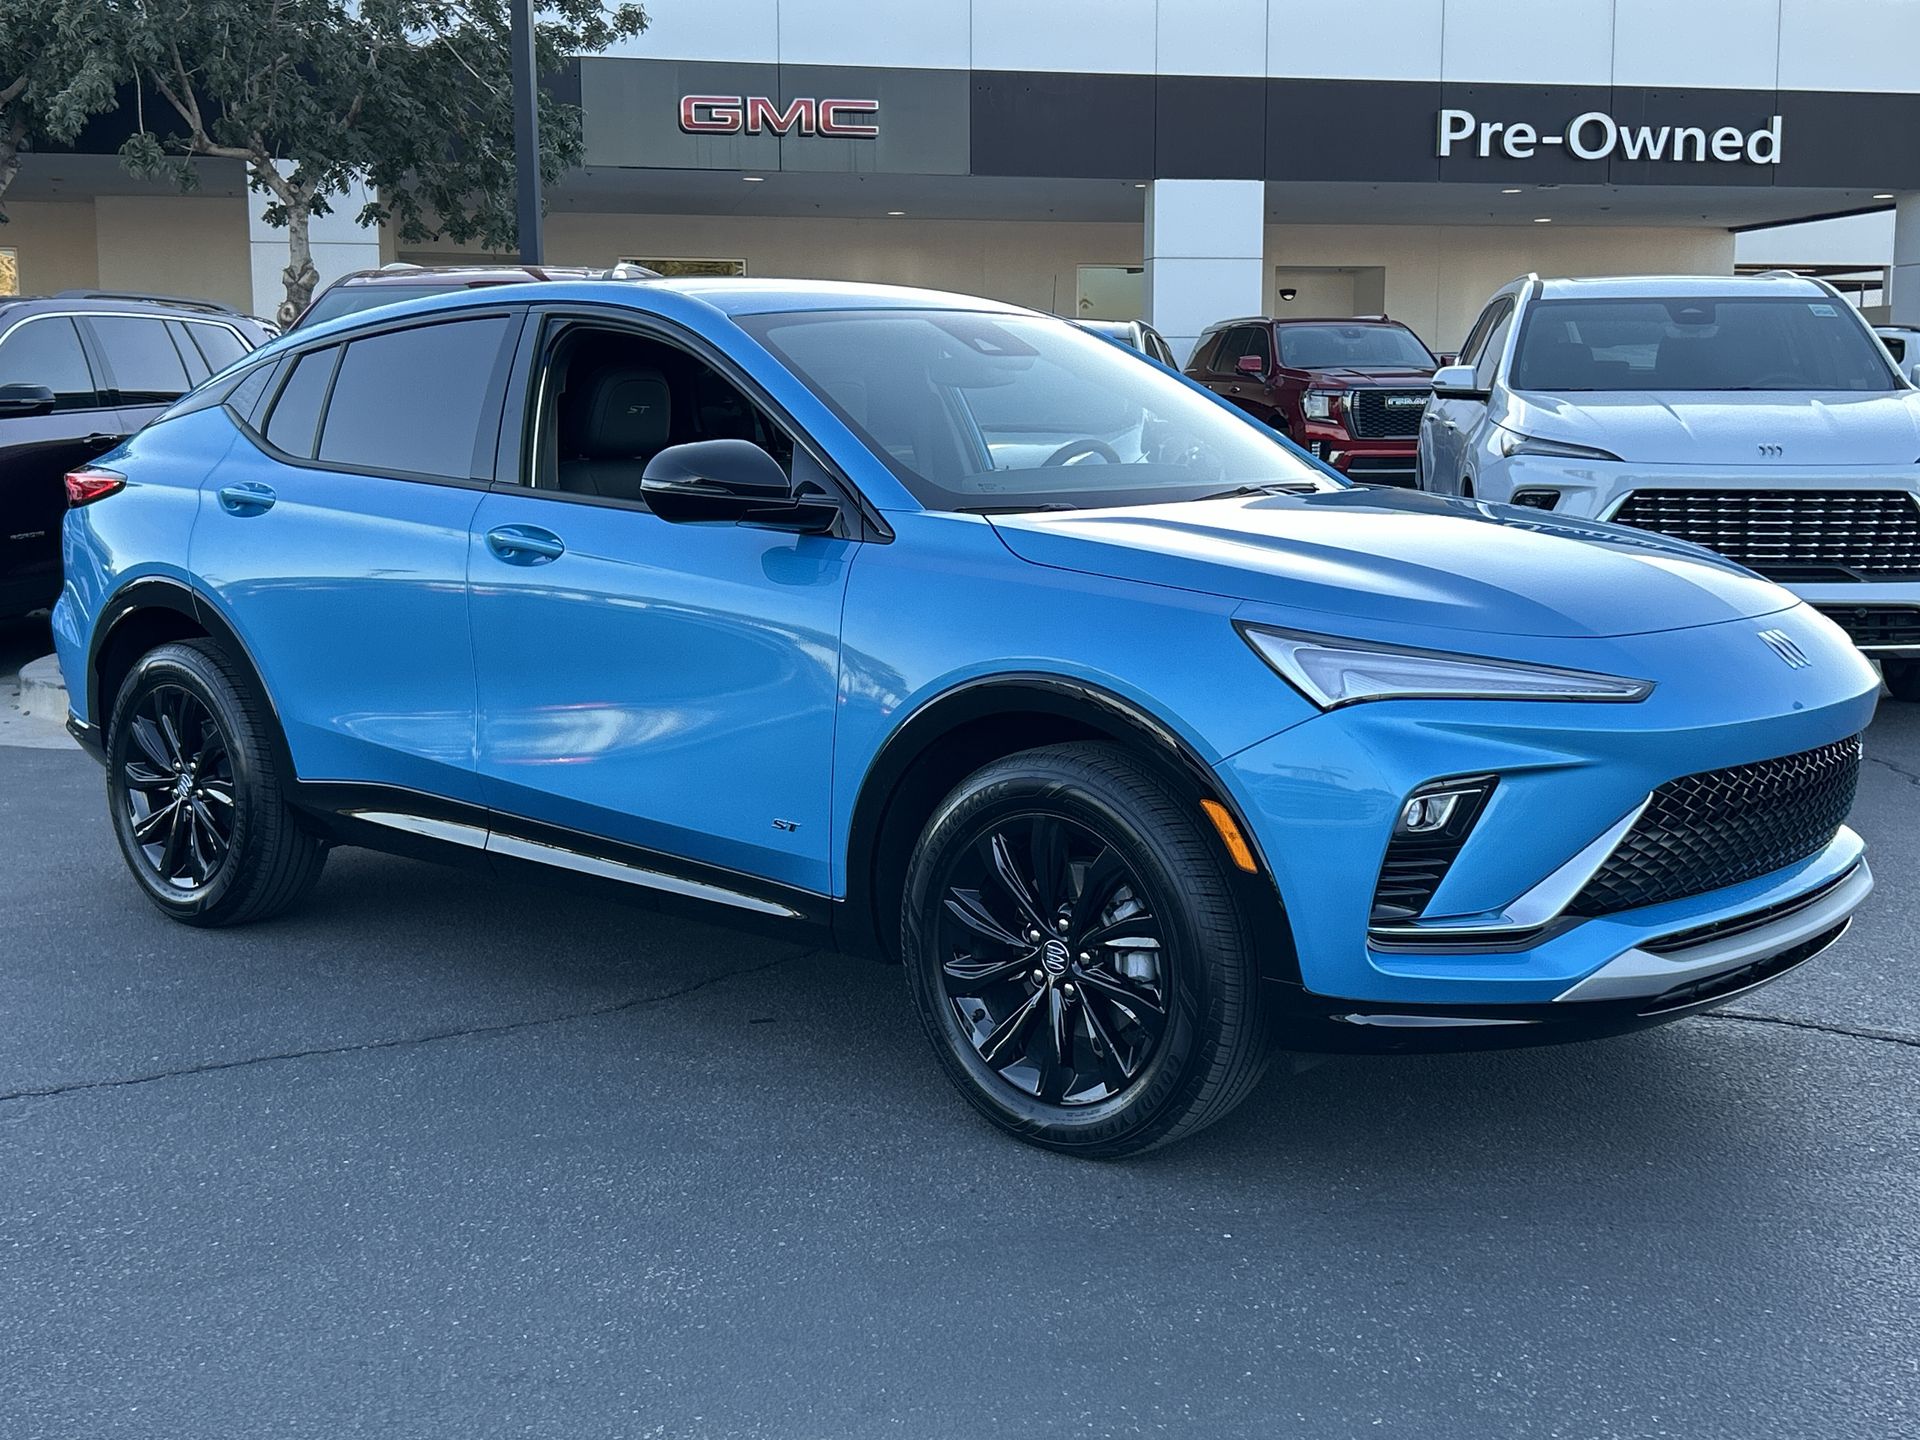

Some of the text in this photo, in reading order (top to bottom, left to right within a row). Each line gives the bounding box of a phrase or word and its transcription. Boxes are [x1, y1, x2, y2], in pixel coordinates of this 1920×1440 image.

[680, 95, 880, 136] GMC
[1437, 109, 1783, 165] Pre-Owned
[627, 405, 650, 414] ST
[771, 818, 801, 832] ST
